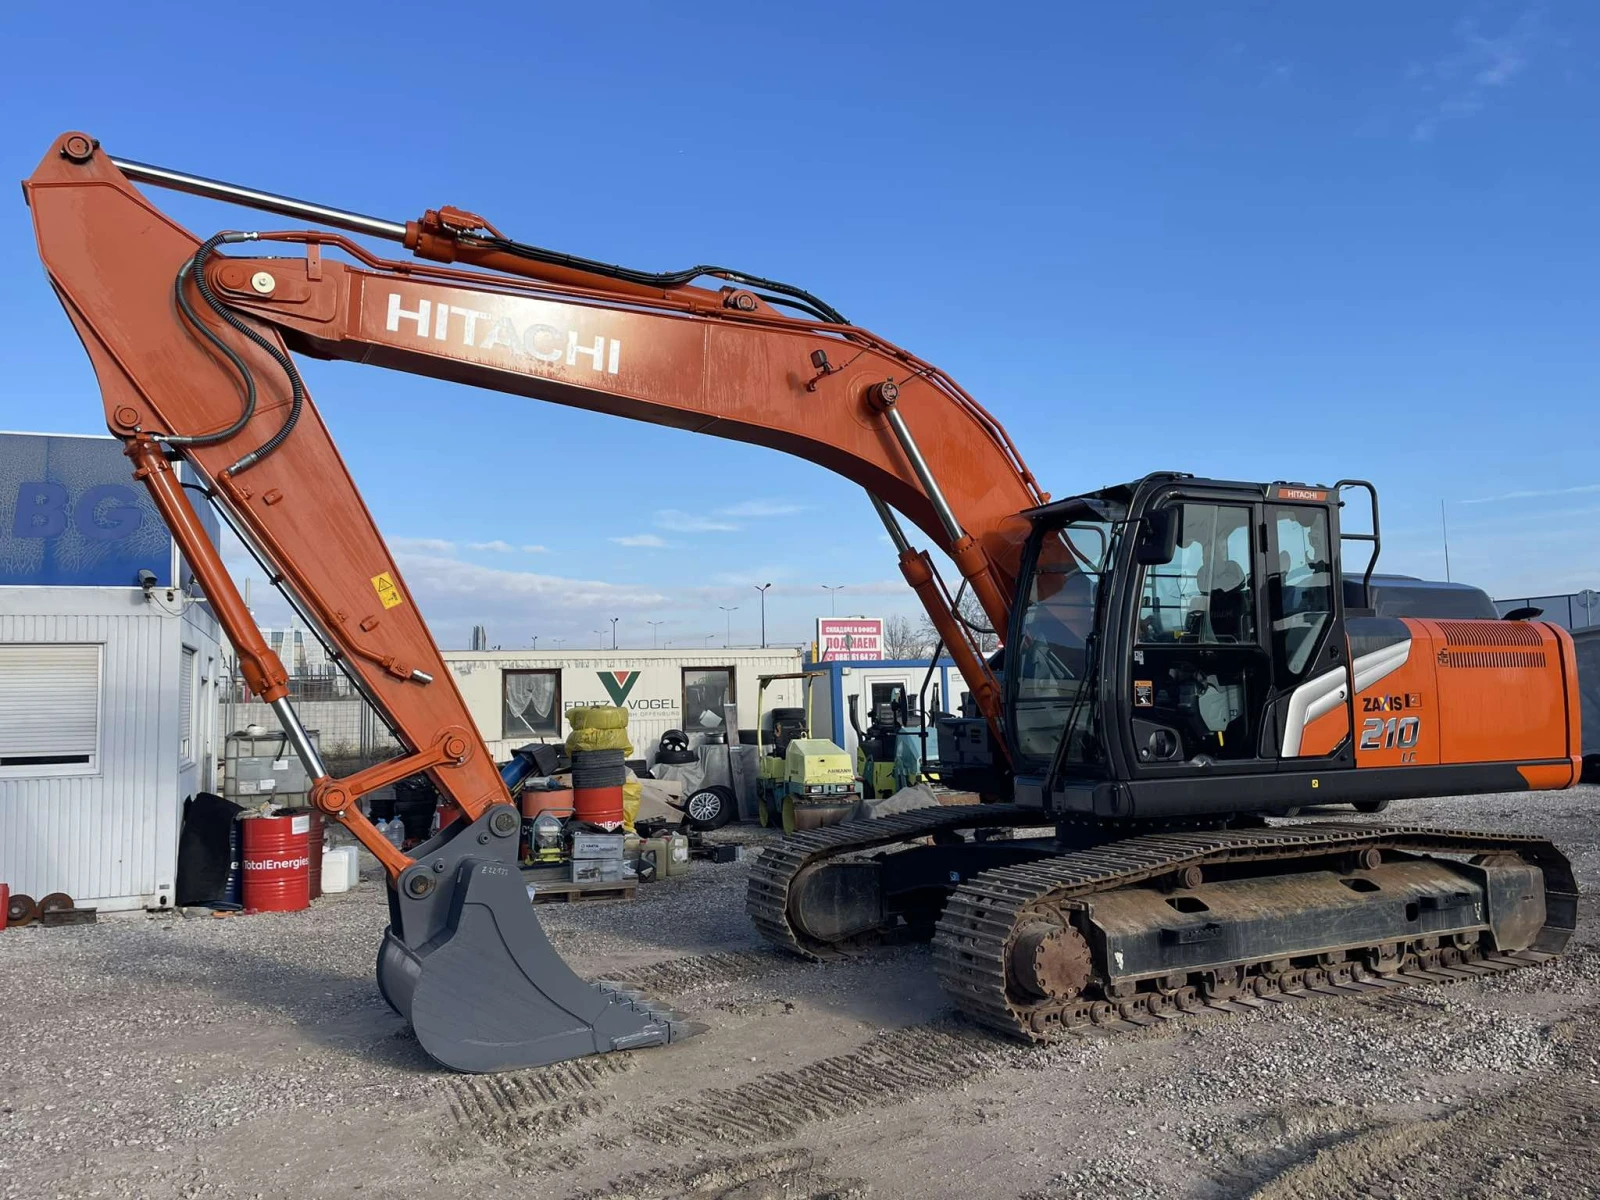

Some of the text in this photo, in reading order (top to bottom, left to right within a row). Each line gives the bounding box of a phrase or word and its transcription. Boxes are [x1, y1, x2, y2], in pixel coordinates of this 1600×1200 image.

[386, 293, 621, 375] HITACHI
[1287, 490, 1318, 499] HITACHI
[628, 699, 680, 709] VOGEL
[1363, 694, 1402, 712] ZAXIS
[1360, 717, 1420, 750] 210
[1401, 752, 1417, 762] LC
[243, 856, 309, 870] TotalEnergies
